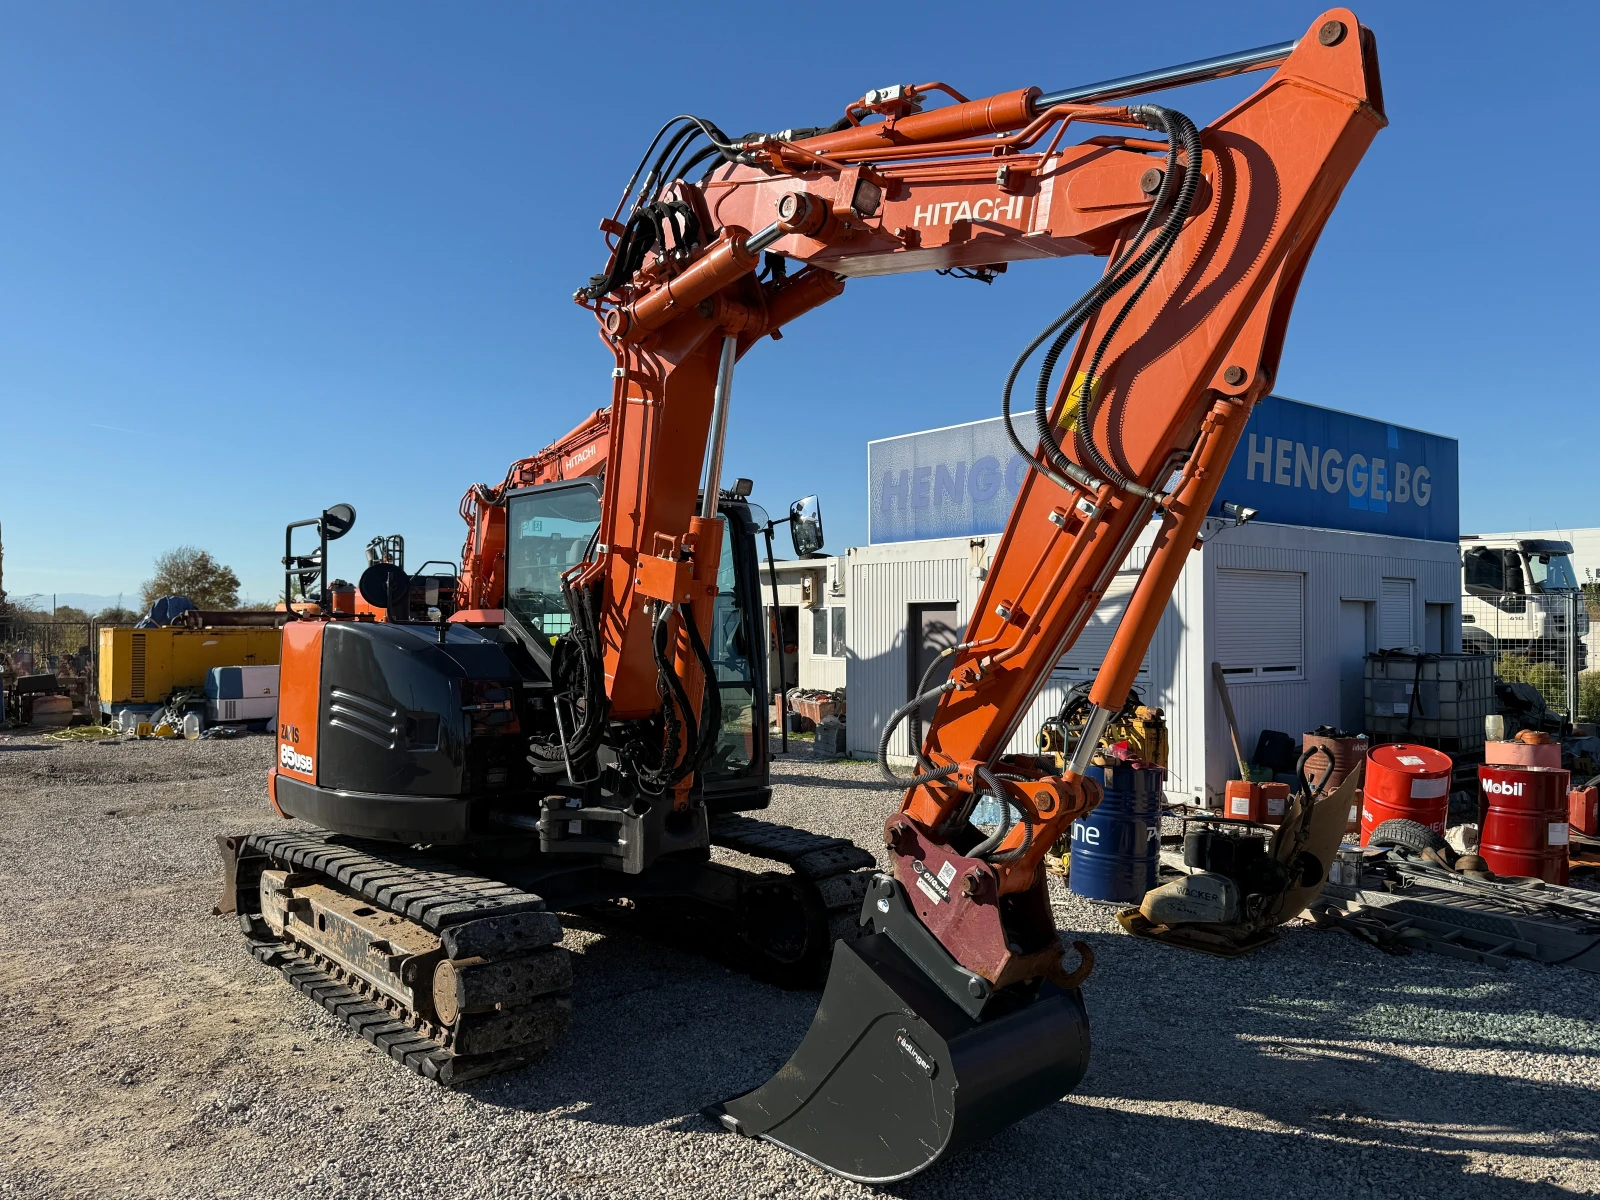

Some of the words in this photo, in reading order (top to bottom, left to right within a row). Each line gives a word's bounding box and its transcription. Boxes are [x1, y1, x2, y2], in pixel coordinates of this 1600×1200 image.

[913, 196, 1024, 226] HITACHI
[565, 444, 597, 471] HITACHI
[1246, 432, 1432, 507] HENGGE.BG
[1482, 778, 1523, 796] Mobil
[1176, 885, 1218, 902] WACKER
